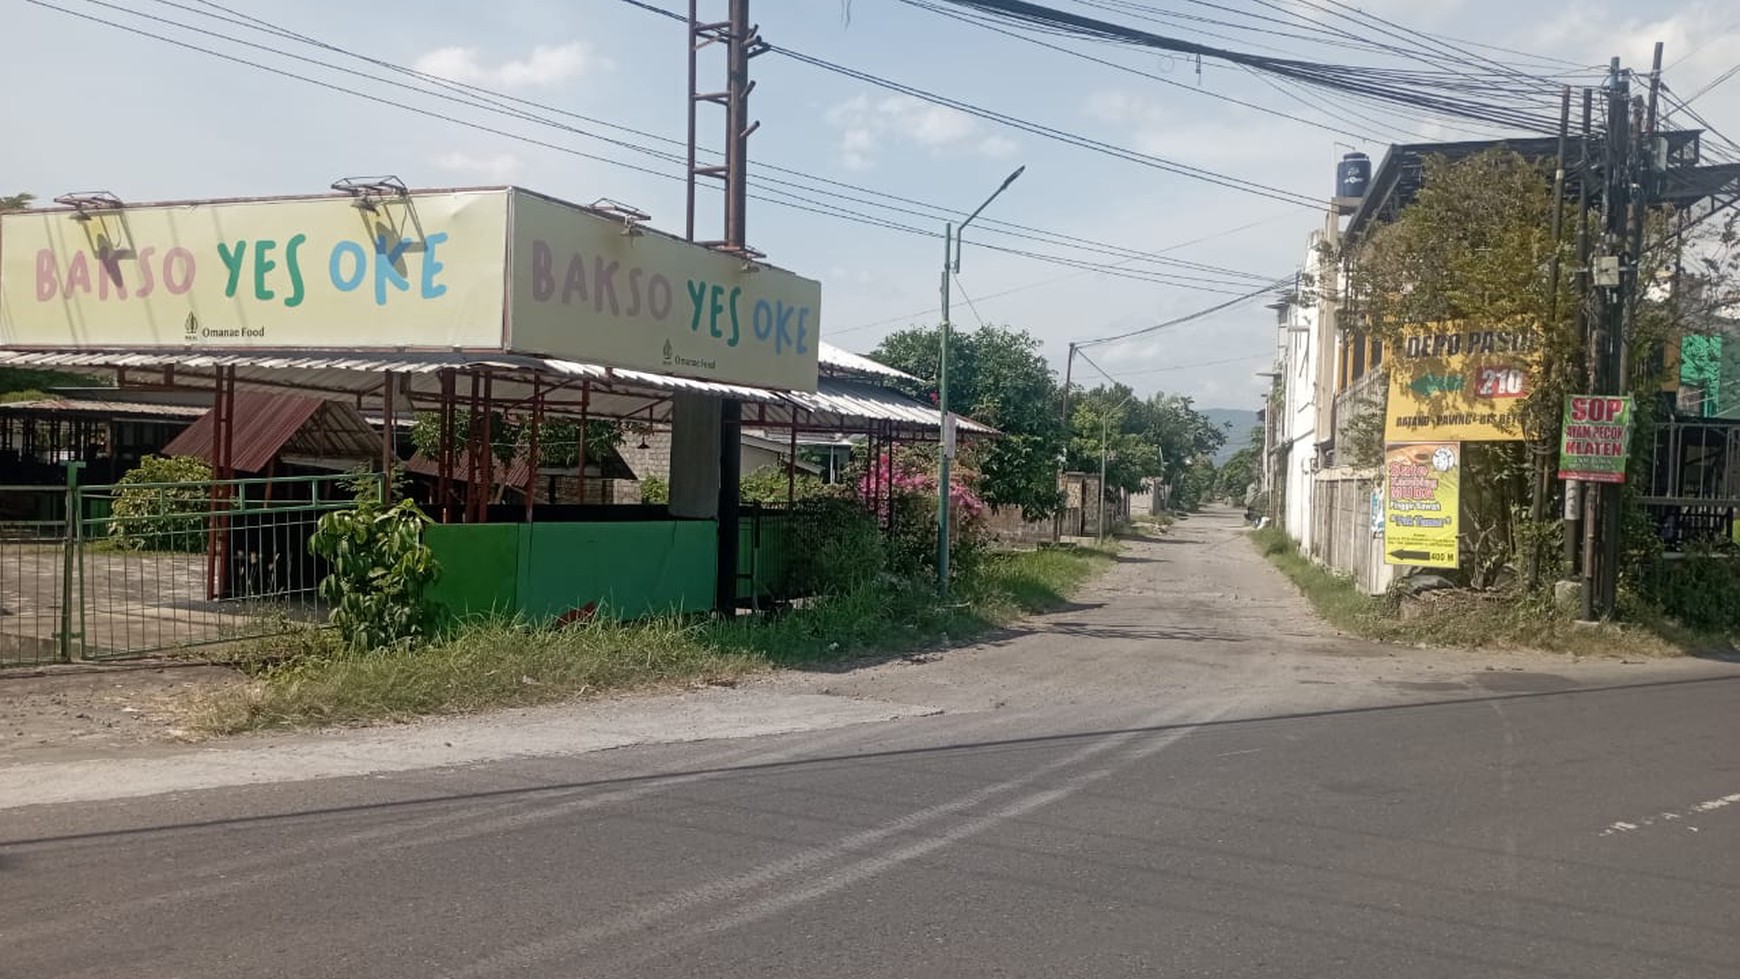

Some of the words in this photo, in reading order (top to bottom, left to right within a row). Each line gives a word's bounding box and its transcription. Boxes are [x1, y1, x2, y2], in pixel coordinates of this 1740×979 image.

[36, 246, 196, 302] BAKSO
[217, 233, 306, 307] YES
[329, 232, 448, 305] OKE
[532, 239, 673, 320] BAKSO
[687, 279, 741, 347] YES
[753, 299, 810, 355] OKE
[241, 325, 265, 337] Food
[1406, 333, 1461, 358] DEPO
[1480, 368, 1524, 395] 210
[1571, 397, 1624, 422] SOP
[1565, 441, 1622, 456] KLATEN
[1447, 553, 1454, 562] M
